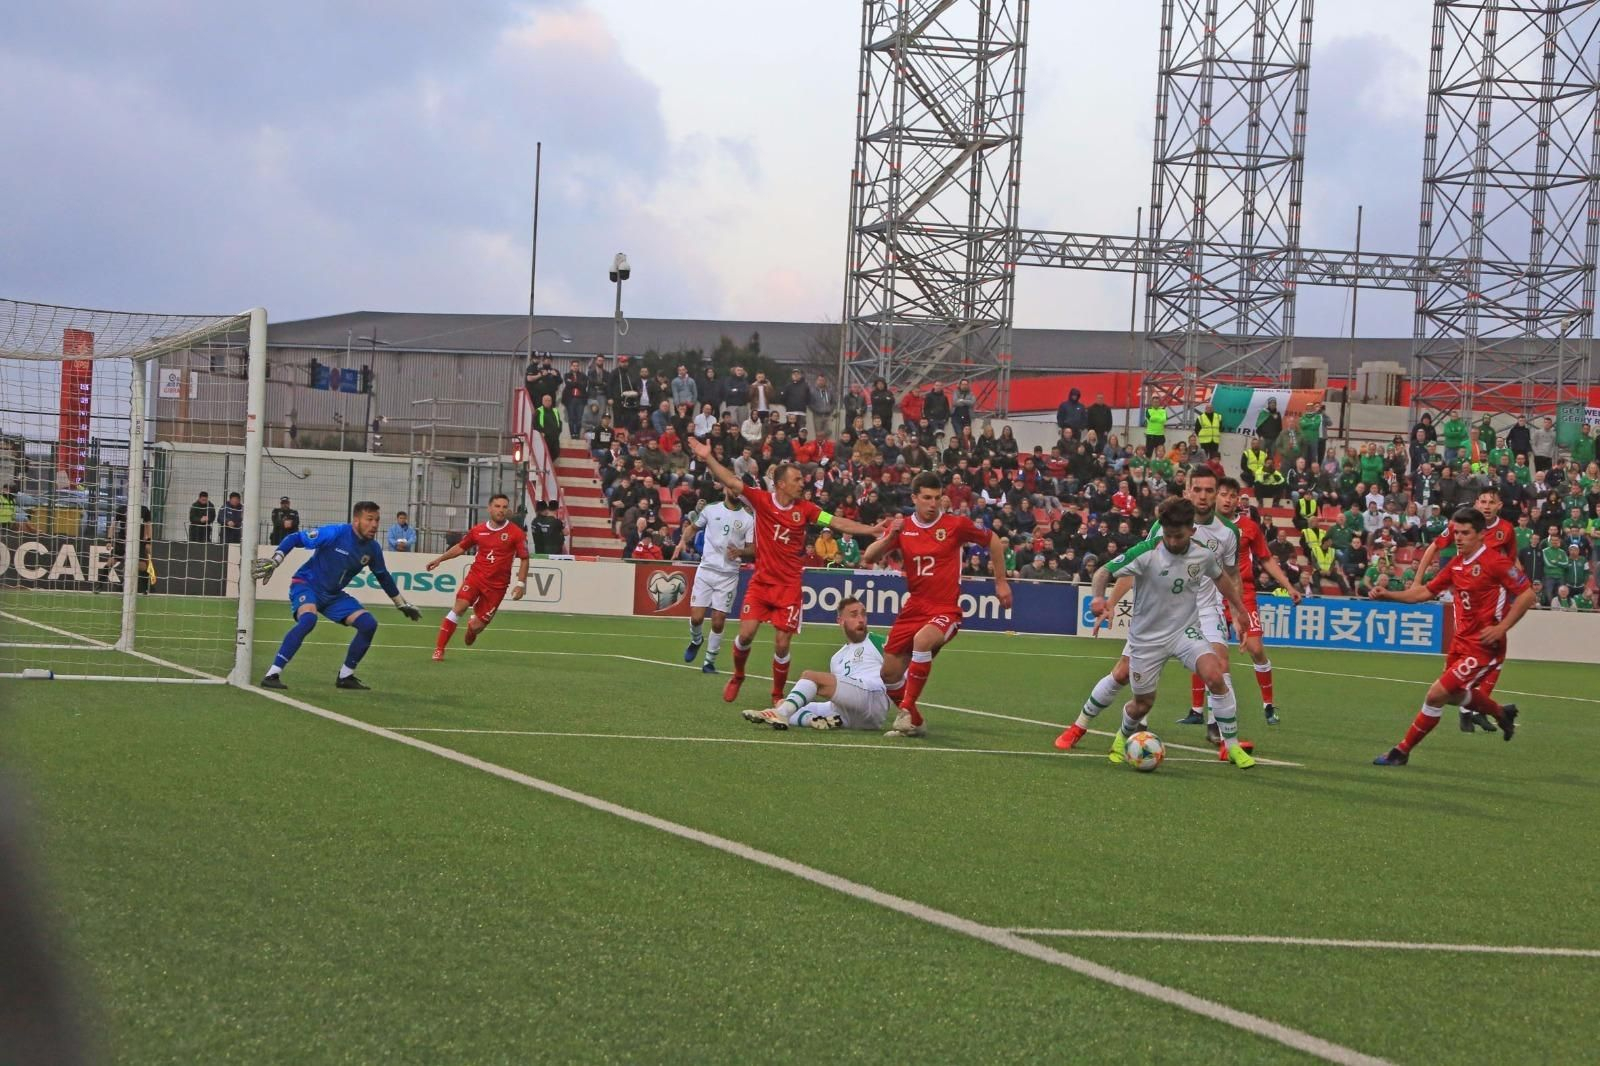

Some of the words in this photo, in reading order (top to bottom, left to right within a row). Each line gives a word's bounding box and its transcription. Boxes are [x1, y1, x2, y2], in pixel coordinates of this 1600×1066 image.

[723, 524, 730, 536] 9
[773, 524, 791, 545] 14
[486, 549, 496, 564] 4
[912, 555, 936, 577] 12
[1171, 578, 1184, 595] 8
[1259, 603, 1434, 647] 就用支付宝
[844, 660, 851, 677] 5
[1457, 656, 1478, 676] 8
